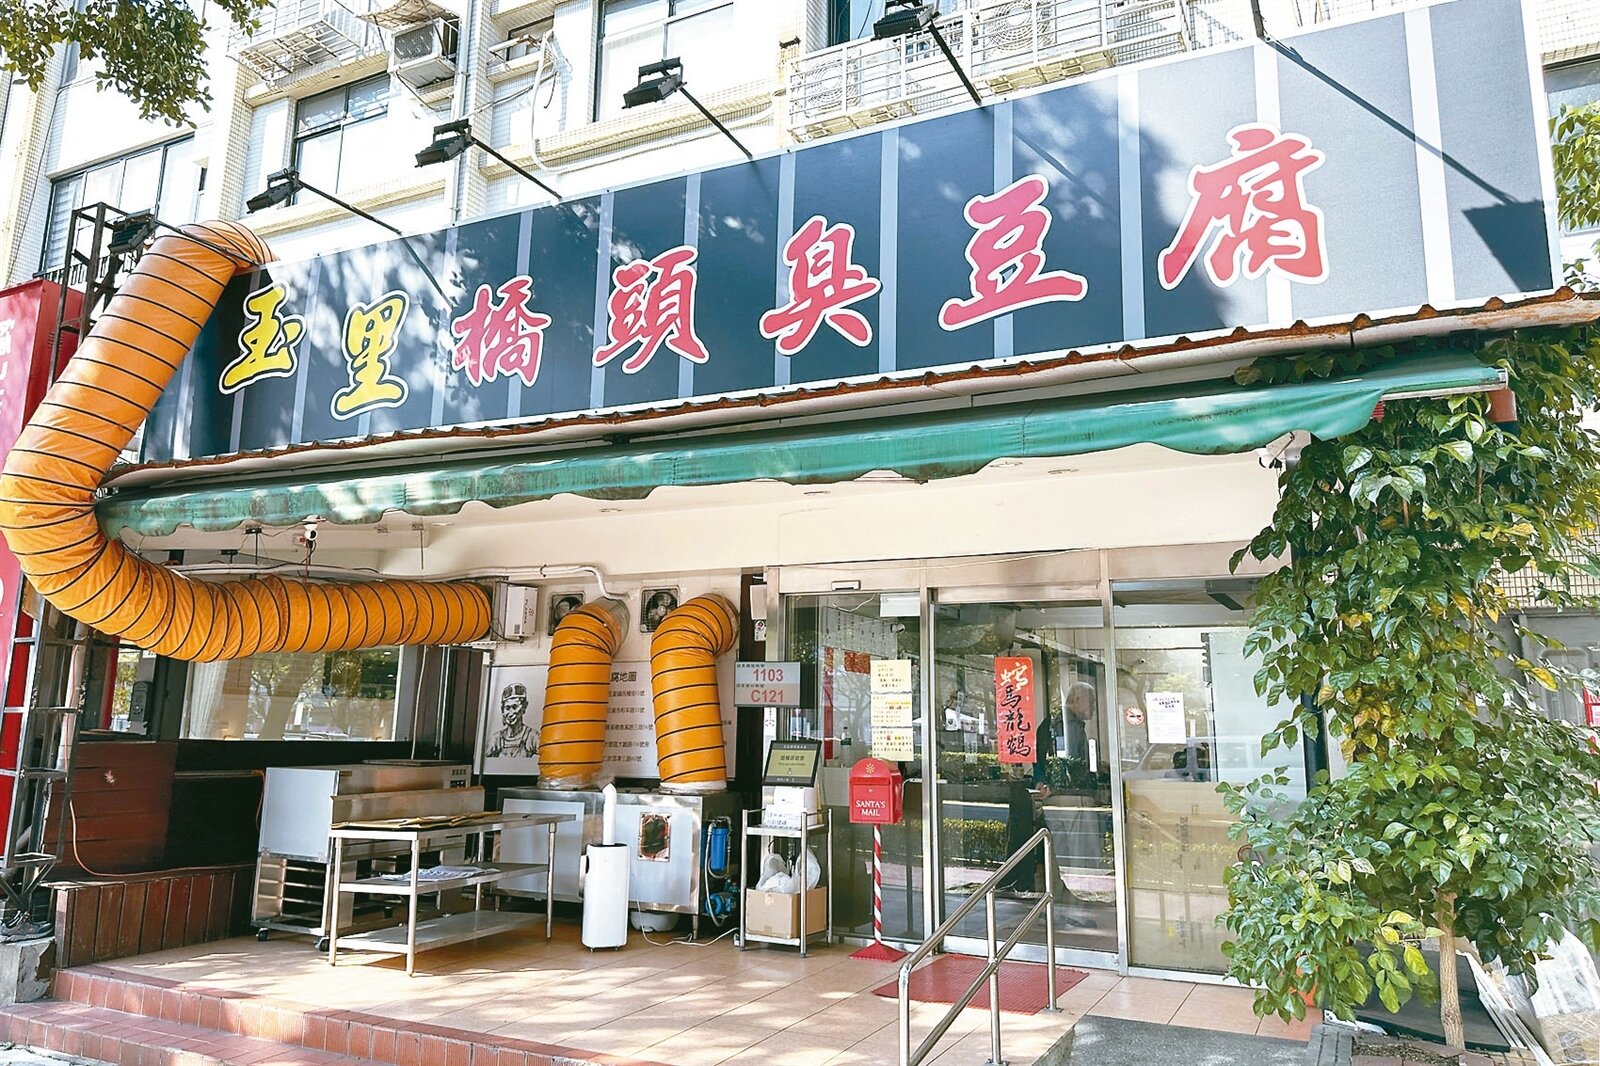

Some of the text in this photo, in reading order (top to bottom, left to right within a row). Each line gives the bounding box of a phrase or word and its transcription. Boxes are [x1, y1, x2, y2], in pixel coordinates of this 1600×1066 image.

[219, 122, 1330, 420] 玉里橋頭臭豆腐
[753, 668, 784, 681] 1103
[751, 689, 784, 703] C121
[856, 799, 886, 809] SANTA'S
[861, 808, 881, 817] MAIL
